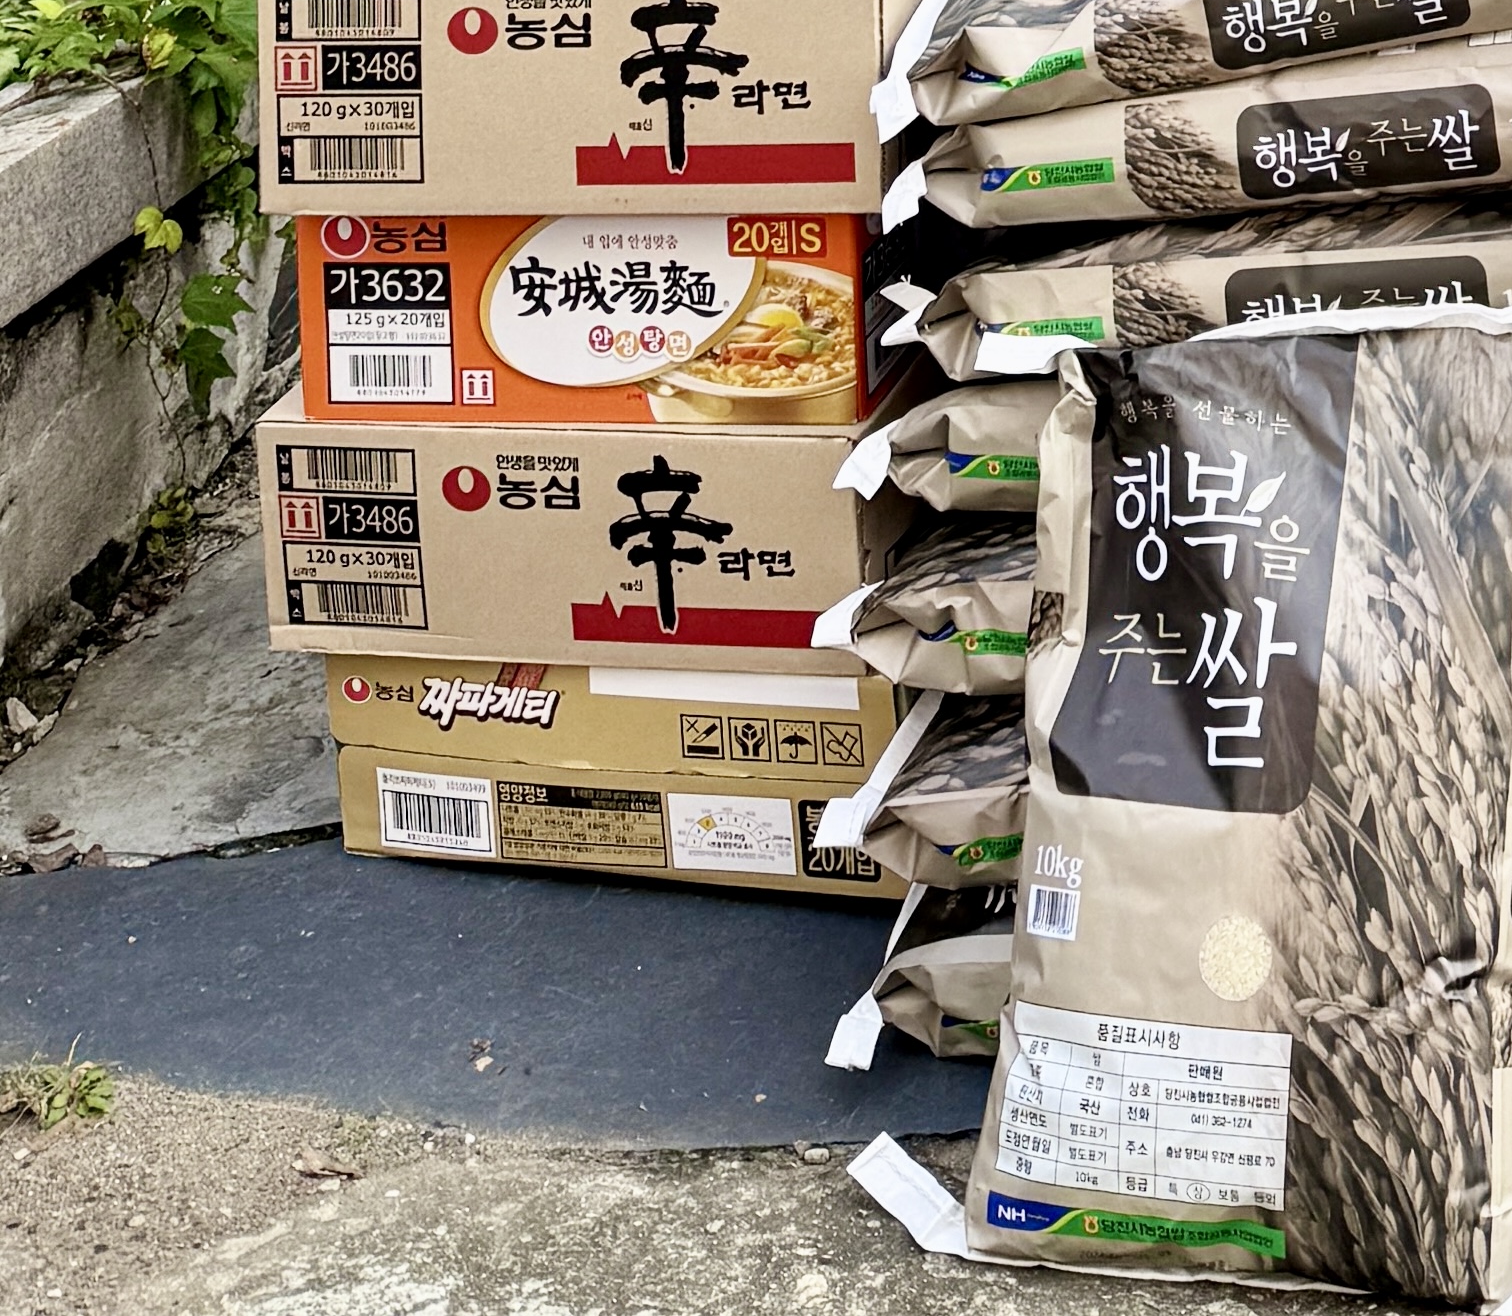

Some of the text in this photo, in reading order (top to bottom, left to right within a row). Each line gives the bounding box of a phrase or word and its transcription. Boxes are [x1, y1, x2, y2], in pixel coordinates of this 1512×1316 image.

[505, 12, 592, 51] 농심
[326, 50, 417, 85] 가3486
[300, 102, 332, 117] 120
[732, 79, 812, 115] 라면
[1253, 126, 1368, 188] 행복을
[371, 221, 448, 254] 농심
[583, 234, 679, 250] 내 입에 안성맞춤
[330, 267, 447, 304] 가3632
[509, 255, 724, 318] 安城湯麵
[346, 313, 372, 326] 125
[591, 326, 691, 357] 안성탕면
[1120, 395, 1178, 424] 행복을
[495, 454, 580, 473] 인생을 맛있게
[496, 473, 581, 510] 농심
[329, 503, 413, 535] 가3486
[1113, 443, 1311, 582] 행복을
[306, 549, 335, 564] 120
[609, 454, 733, 631] 辛
[717, 548, 795, 581] 라면
[376, 677, 560, 730] 농심 짜파게티
[499, 783, 549, 803] 영양정보
[1035, 844, 1084, 889] 10kg
[1097, 1023, 1181, 1051] 품질표시사항
[1129, 1083, 1151, 1097] 상호
[1080, 1098, 1149, 1122] 국산 전화
[1069, 1123, 1108, 1140] 별도표기
[1069, 1147, 1108, 1165] 별도표기
[1125, 1140, 1149, 1156] 주소
[1075, 1171, 1099, 1186] 10kg
[1126, 1176, 1148, 1192] 등급
[997, 1204, 1026, 1223] NH
